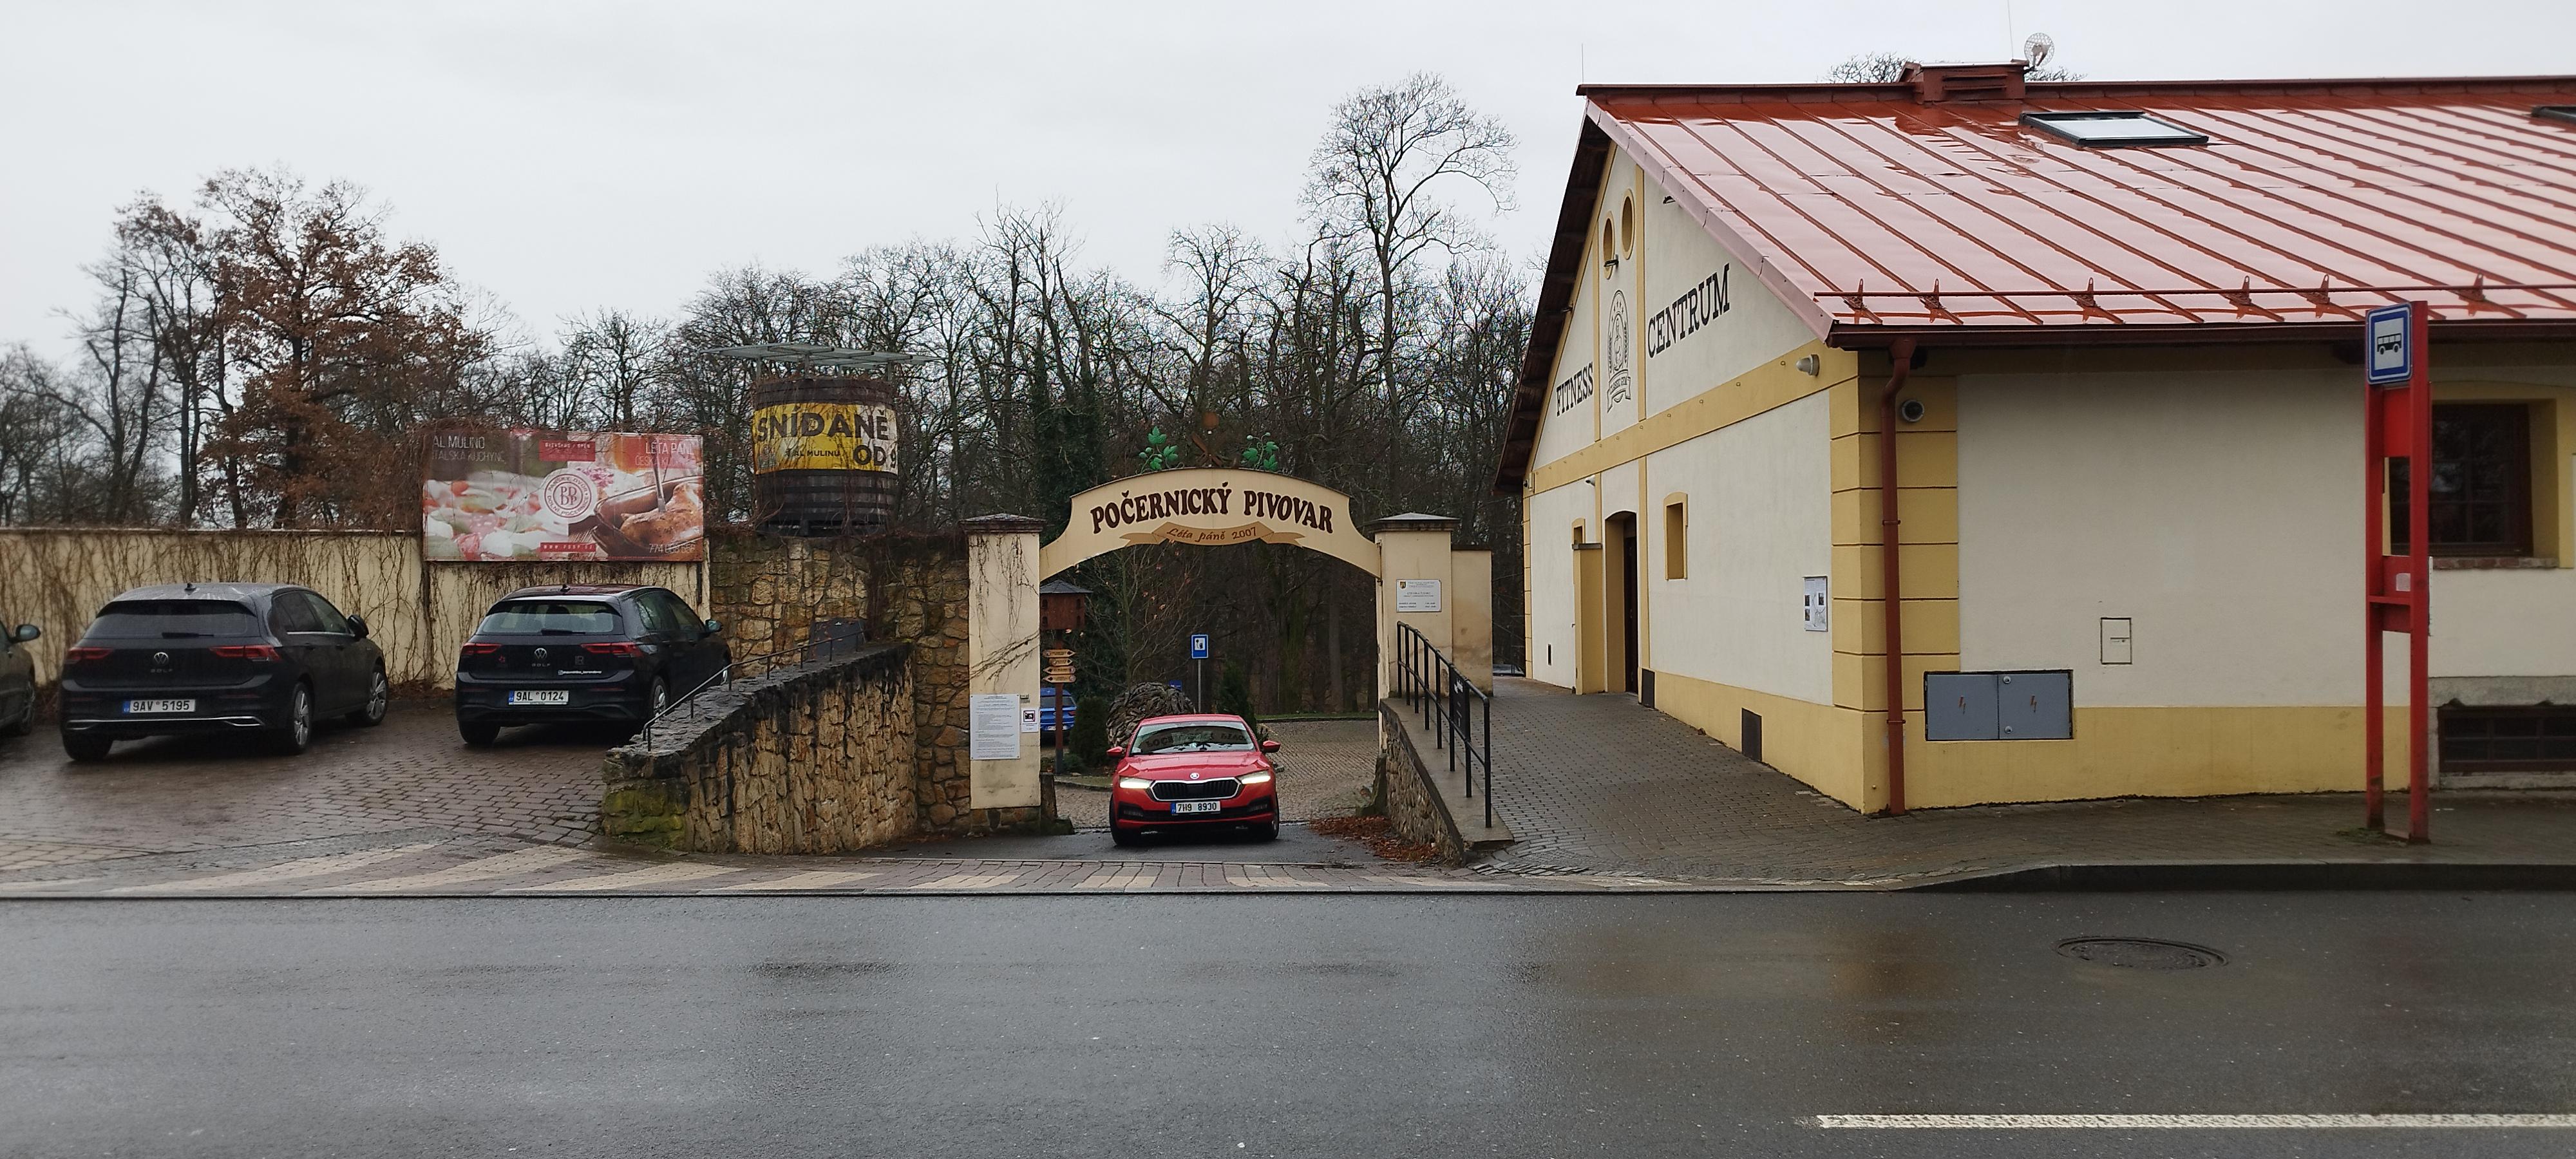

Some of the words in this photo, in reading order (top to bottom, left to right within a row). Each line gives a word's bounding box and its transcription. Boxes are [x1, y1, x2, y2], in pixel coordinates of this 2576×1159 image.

[1647, 263, 1730, 358] CENTRUM
[1557, 361, 1593, 417] FITNESS
[757, 406, 889, 442] SNÍDANĚ
[433, 435, 446, 448] AL
[448, 435, 484, 448] MULINO
[853, 445, 886, 466] OD
[1090, 482, 1232, 534] POČERNICKÝ
[1244, 490, 1333, 534] PIVOVAR
[1166, 528, 1193, 538] Léta
[1195, 531, 1225, 542] páně
[1232, 527, 1256, 540] 2007
[133, 701, 153, 711] 9AV
[162, 700, 190, 710] 5195
[516, 692, 533, 701] 9AL
[541, 692, 564, 701] 0124
[1198, 802, 1217, 811] 8930
